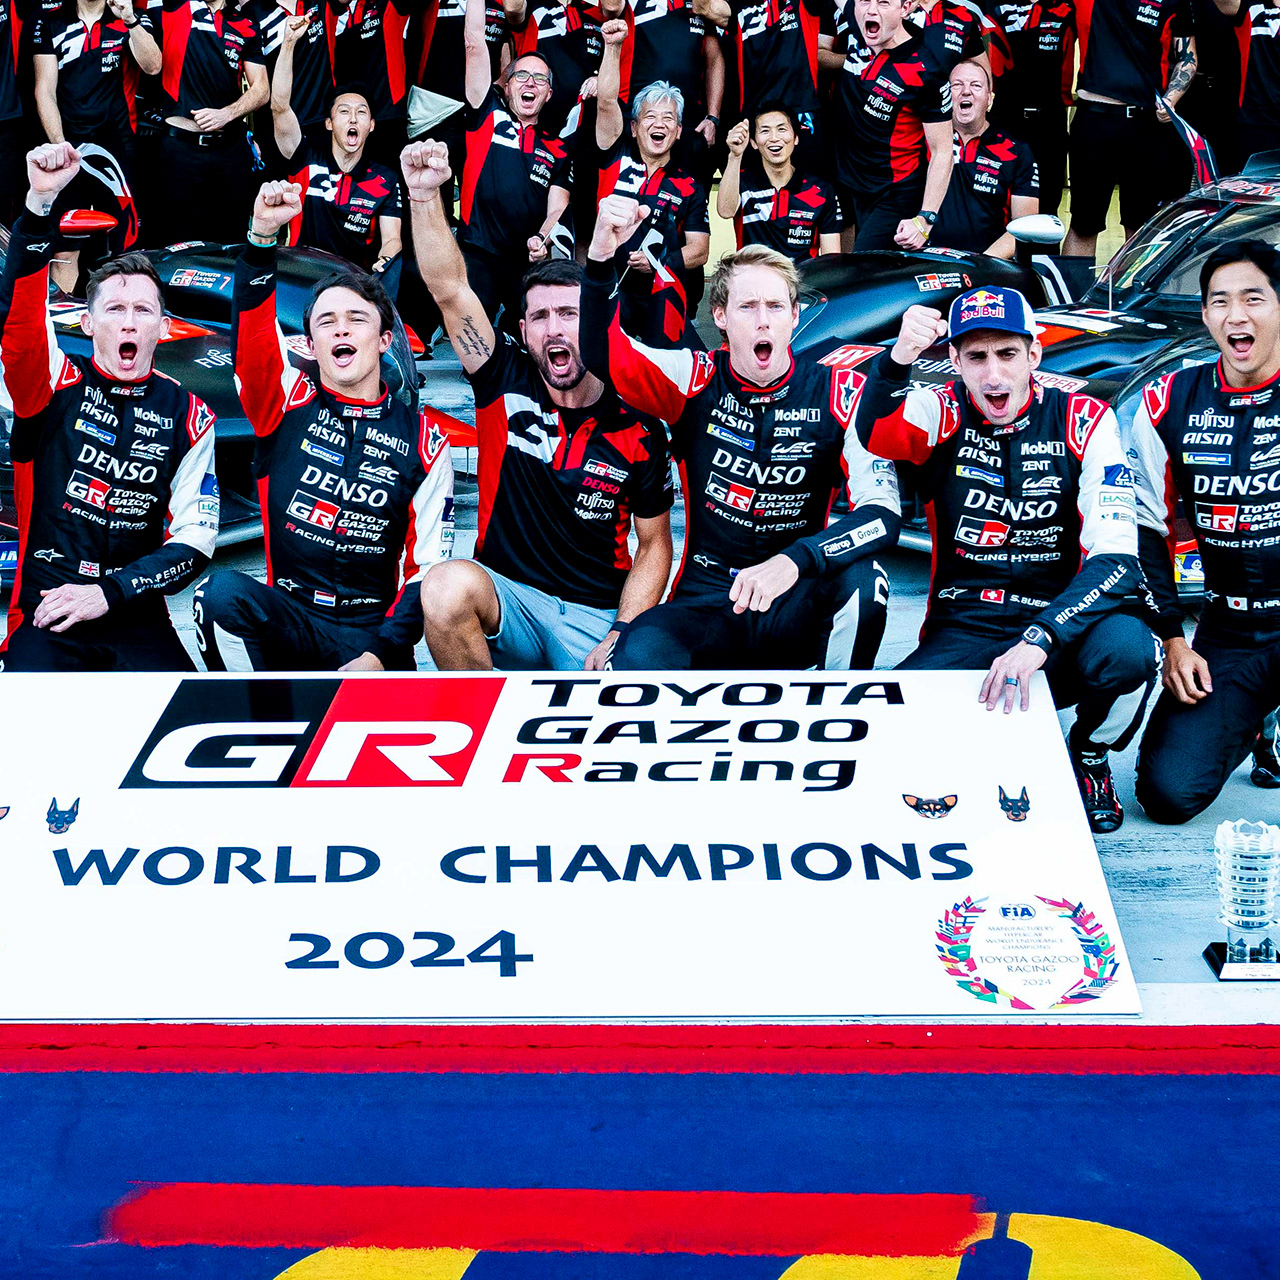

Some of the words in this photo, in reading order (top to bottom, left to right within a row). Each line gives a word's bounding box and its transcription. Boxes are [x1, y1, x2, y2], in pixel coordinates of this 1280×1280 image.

[868, 95, 894, 113] FUJITSU
[974, 173, 998, 186] FUJITSU
[963, 274, 972, 287] 8
[982, 305, 1005, 318] Bull
[823, 346, 871, 365] HY
[80, 402, 118, 427] AISIN
[1189, 408, 1234, 430] FUJITSU
[134, 423, 158, 438] ZENT
[308, 422, 346, 447] AISIN
[774, 427, 801, 437] ZENT
[1183, 432, 1232, 445] AISIN
[77, 443, 157, 483] DENSO
[364, 444, 391, 460] ZENT
[712, 448, 806, 485] DENSO
[1022, 460, 1050, 471] ZENT
[68, 480, 106, 507] GR
[300, 464, 388, 507] DENSO
[582, 477, 620, 495] DENSO
[707, 484, 751, 508] GR
[757, 492, 810, 501] TOYOTA
[577, 492, 615, 511] FUJITSU
[753, 507, 801, 517] Racing
[964, 488, 1058, 521] DENSO
[62, 502, 106, 525] RACING
[288, 500, 335, 529] GR
[705, 501, 753, 528] RACING
[1197, 511, 1234, 531] GR
[285, 522, 335, 547] RACING
[857, 525, 880, 540] Group
[957, 524, 1010, 546] GR
[955, 548, 1007, 561] RACING
[1054, 588, 1100, 625] RICHARD
[1099, 564, 1128, 594] MILLE
[531, 677, 904, 707] TOYOTA
[517, 716, 868, 744] GAZOO
[139, 719, 477, 787] GR
[503, 752, 856, 792] Racing
[53, 846, 380, 886] WORLD
[440, 842, 973, 884] CHAMPIONS
[1001, 907, 1033, 917] FIA
[285, 929, 534, 978] 2024
[979, 955, 1027, 963] TOYOTA
[1031, 955, 1079, 963] GAZOO
[1022, 978, 1051, 986] 2024
